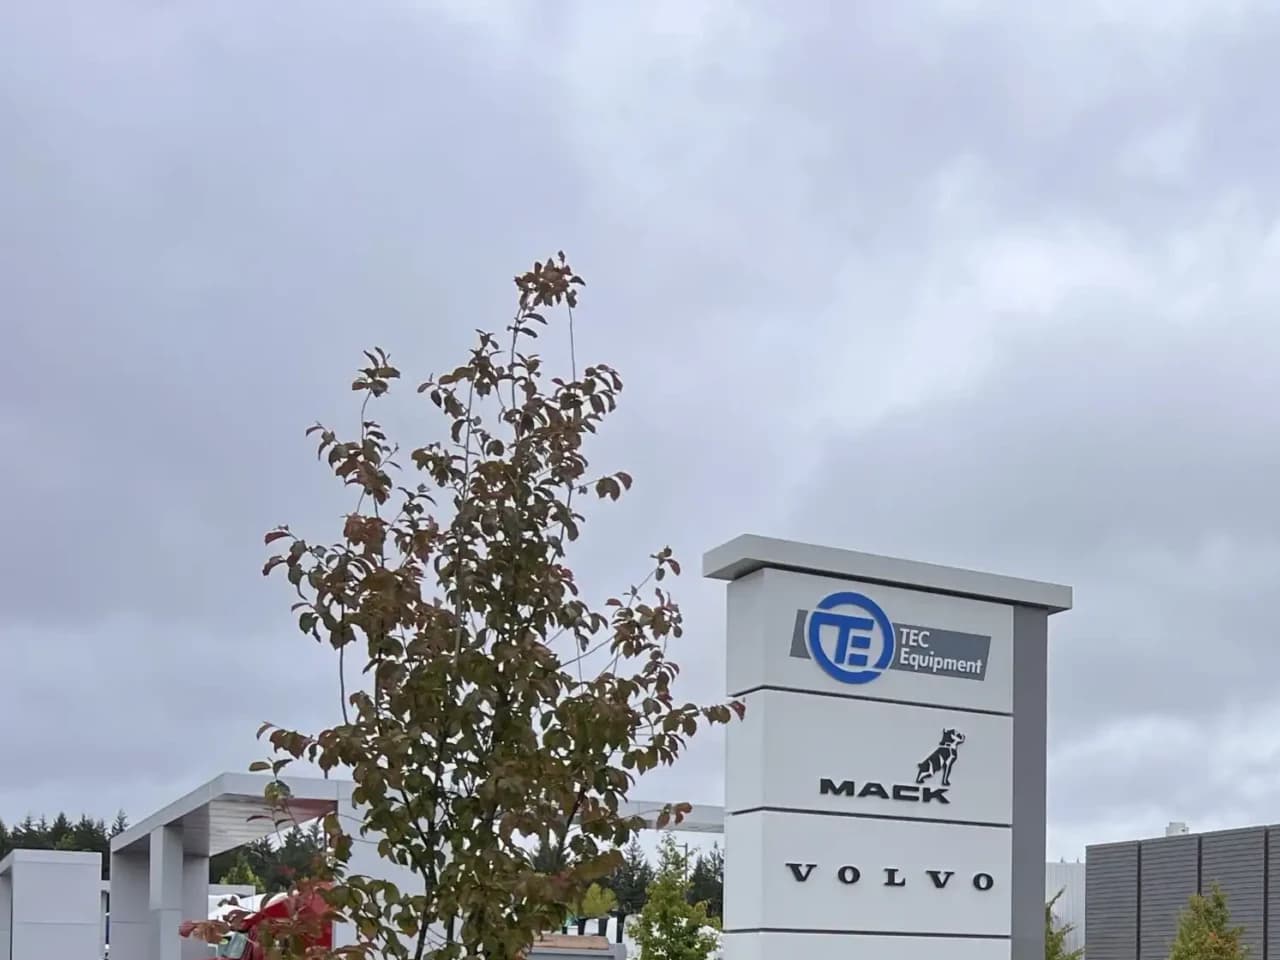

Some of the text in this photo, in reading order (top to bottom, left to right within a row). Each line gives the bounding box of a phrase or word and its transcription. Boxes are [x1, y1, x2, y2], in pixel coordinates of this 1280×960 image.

[900, 628, 930, 648] TEC
[899, 649, 983, 675] Equipment
[819, 778, 951, 804] MACK
[786, 863, 994, 891] VOLVO
